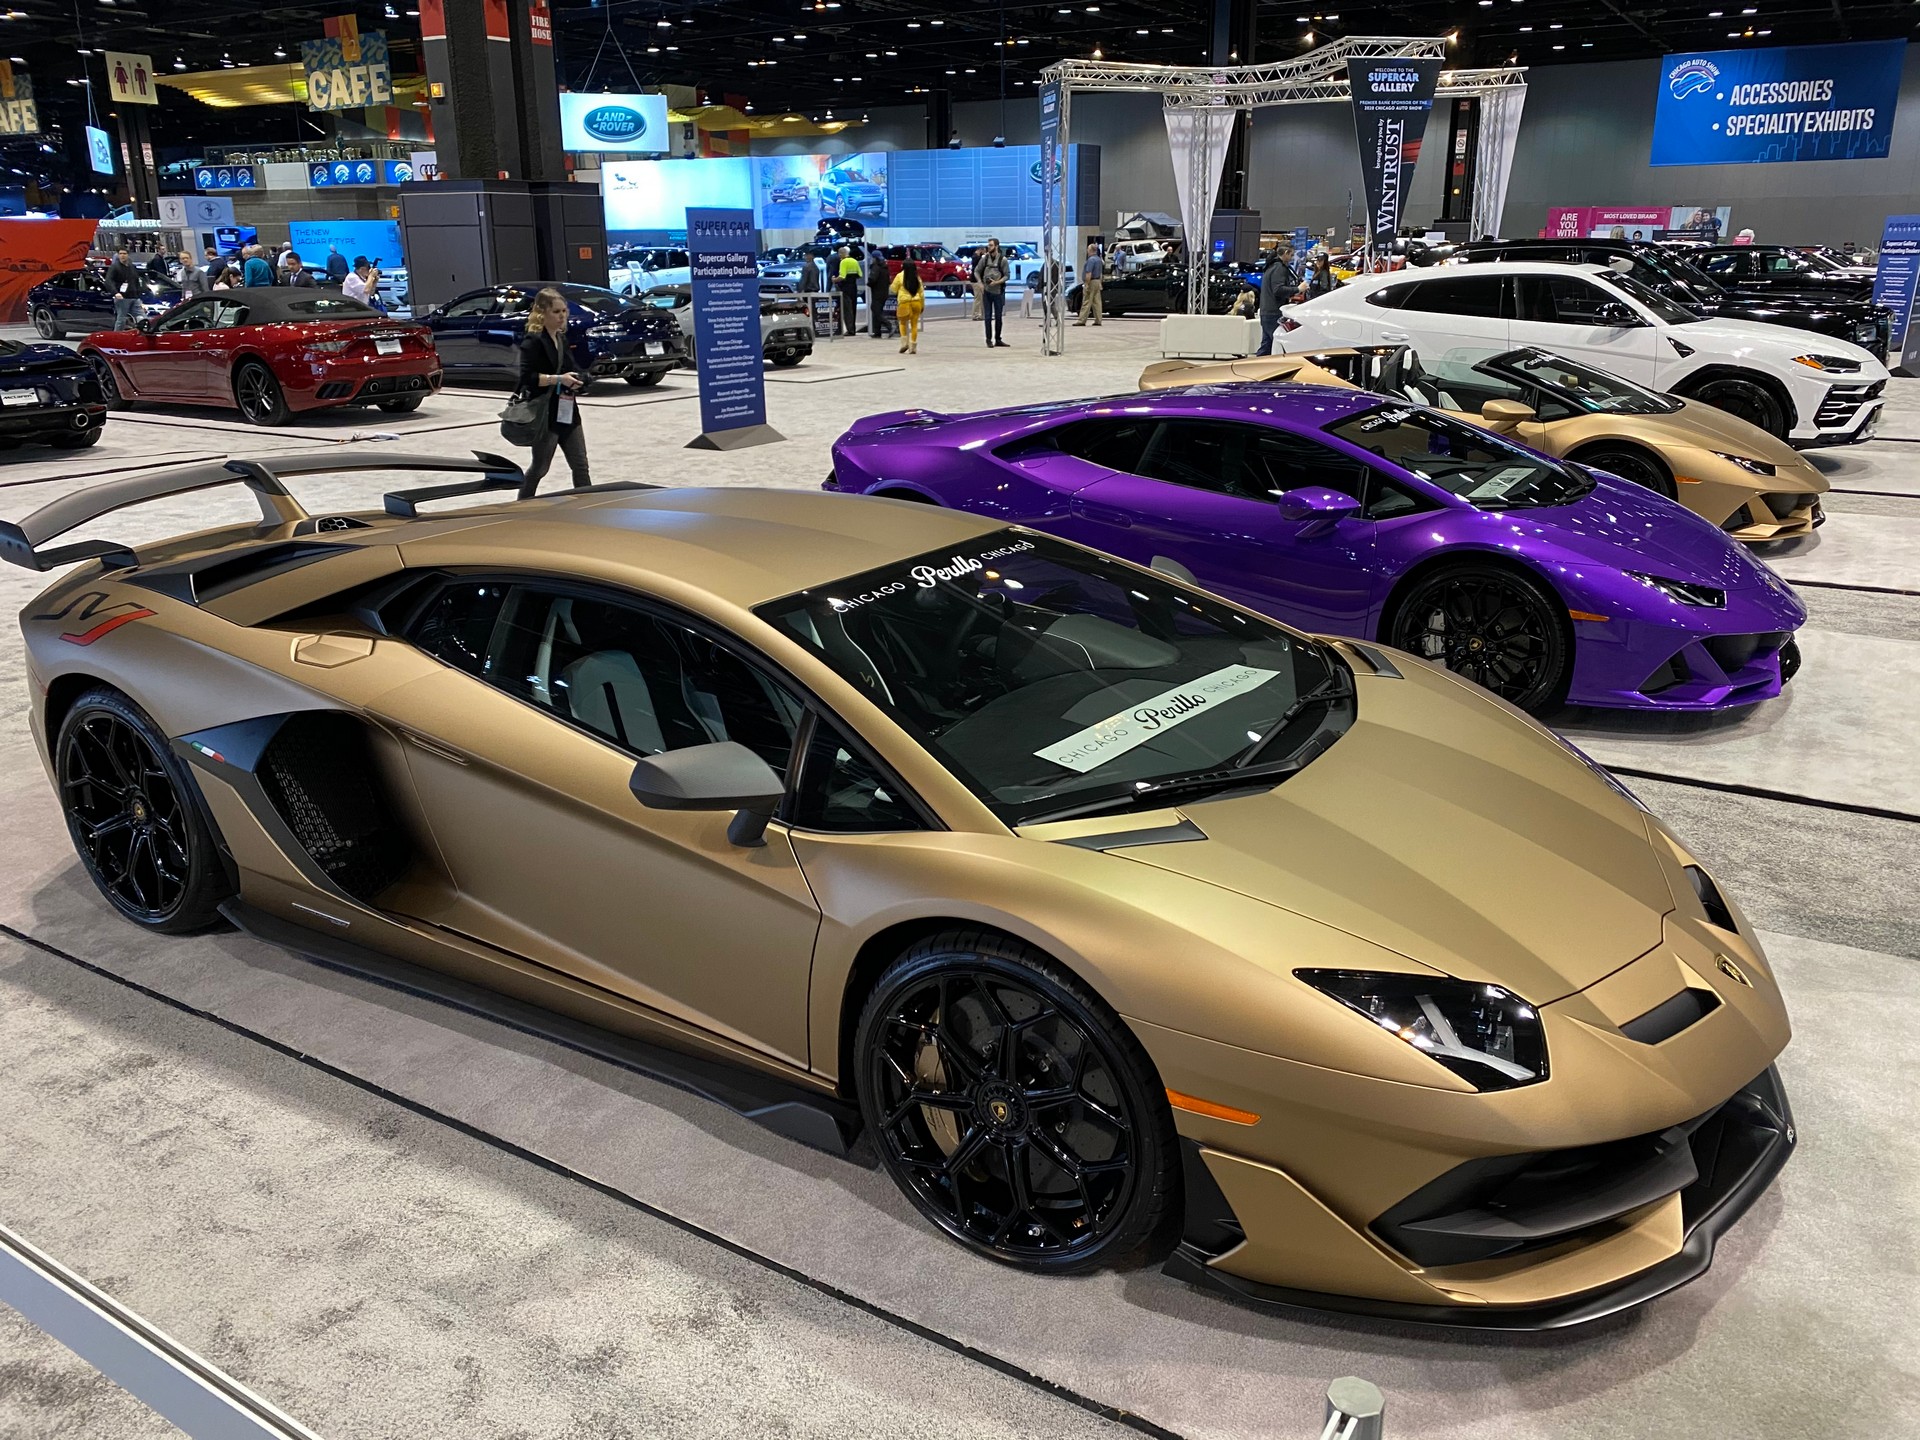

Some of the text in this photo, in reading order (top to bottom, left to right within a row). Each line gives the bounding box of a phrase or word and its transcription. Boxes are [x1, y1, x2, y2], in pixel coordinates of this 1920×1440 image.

[531, 15, 550, 28] FIRE
[531, 28, 552, 40] HOSE
[1669, 60, 1692, 79] CHICAGO
[1706, 62, 1720, 76] SHOW
[1368, 72, 1419, 82] SUPERCAR
[308, 64, 390, 108] CAFE
[1371, 83, 1415, 92] GALLERY
[1730, 79, 1834, 106] ACCESSORIES
[596, 112, 624, 122] LAND
[1726, 108, 1875, 136] SPECIALTY EXHIBITS
[599, 122, 635, 132] ROVER
[1376, 118, 1400, 234] WINTRUST
[694, 221, 750, 230] SUPER CAR
[698, 253, 748, 264] Supercar Gallery
[694, 266, 756, 277] Participating Dealers
[833, 540, 1035, 613] CHICAGO Perillo CHICAGO
[1058, 670, 1257, 764] CHICAGO Perillo CHICAGO
